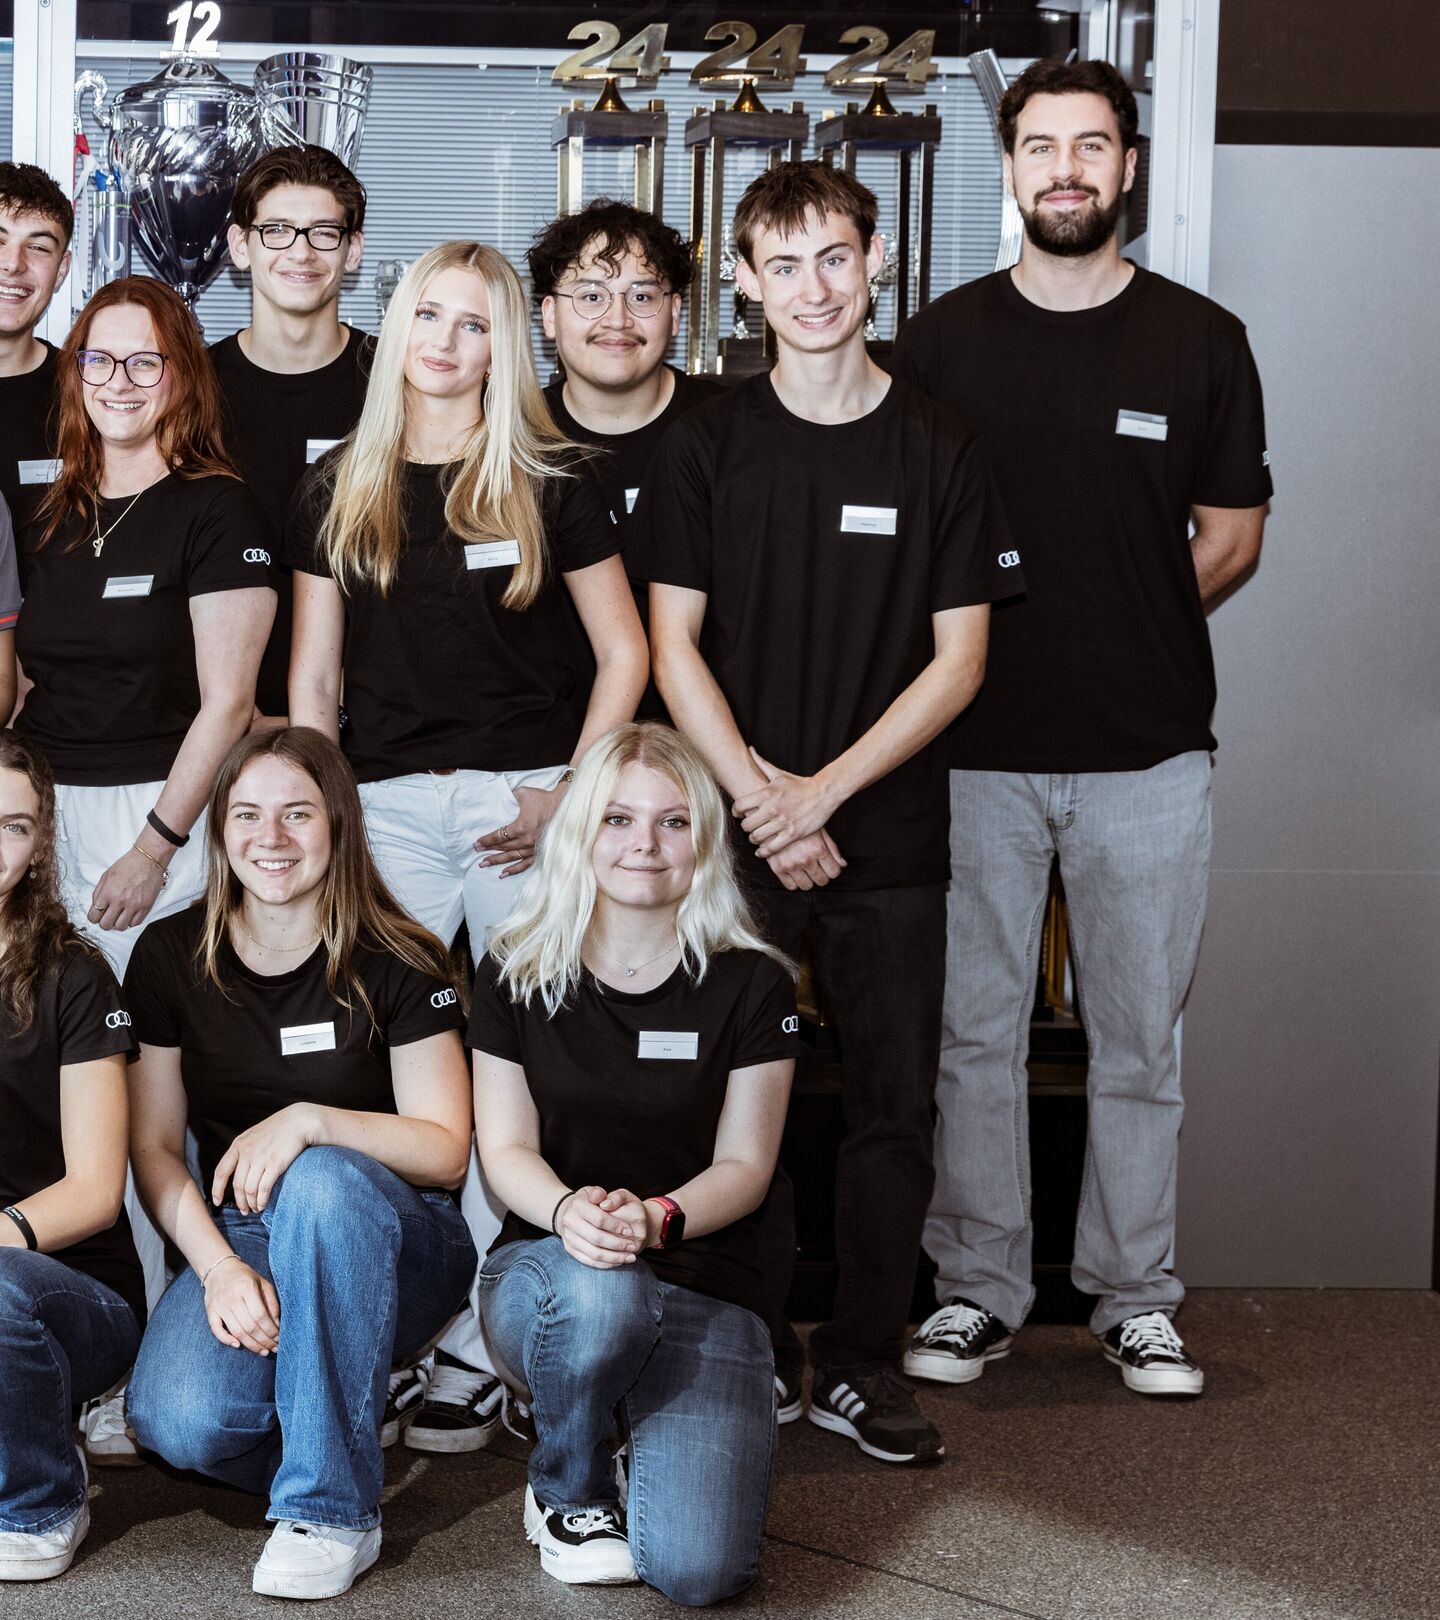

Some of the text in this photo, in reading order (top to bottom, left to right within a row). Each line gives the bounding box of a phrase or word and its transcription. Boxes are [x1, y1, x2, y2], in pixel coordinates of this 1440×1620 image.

[166, 1, 221, 51] 12
[551, 20, 670, 80] 24
[688, 20, 807, 81] 24
[824, 25, 939, 83] 24
